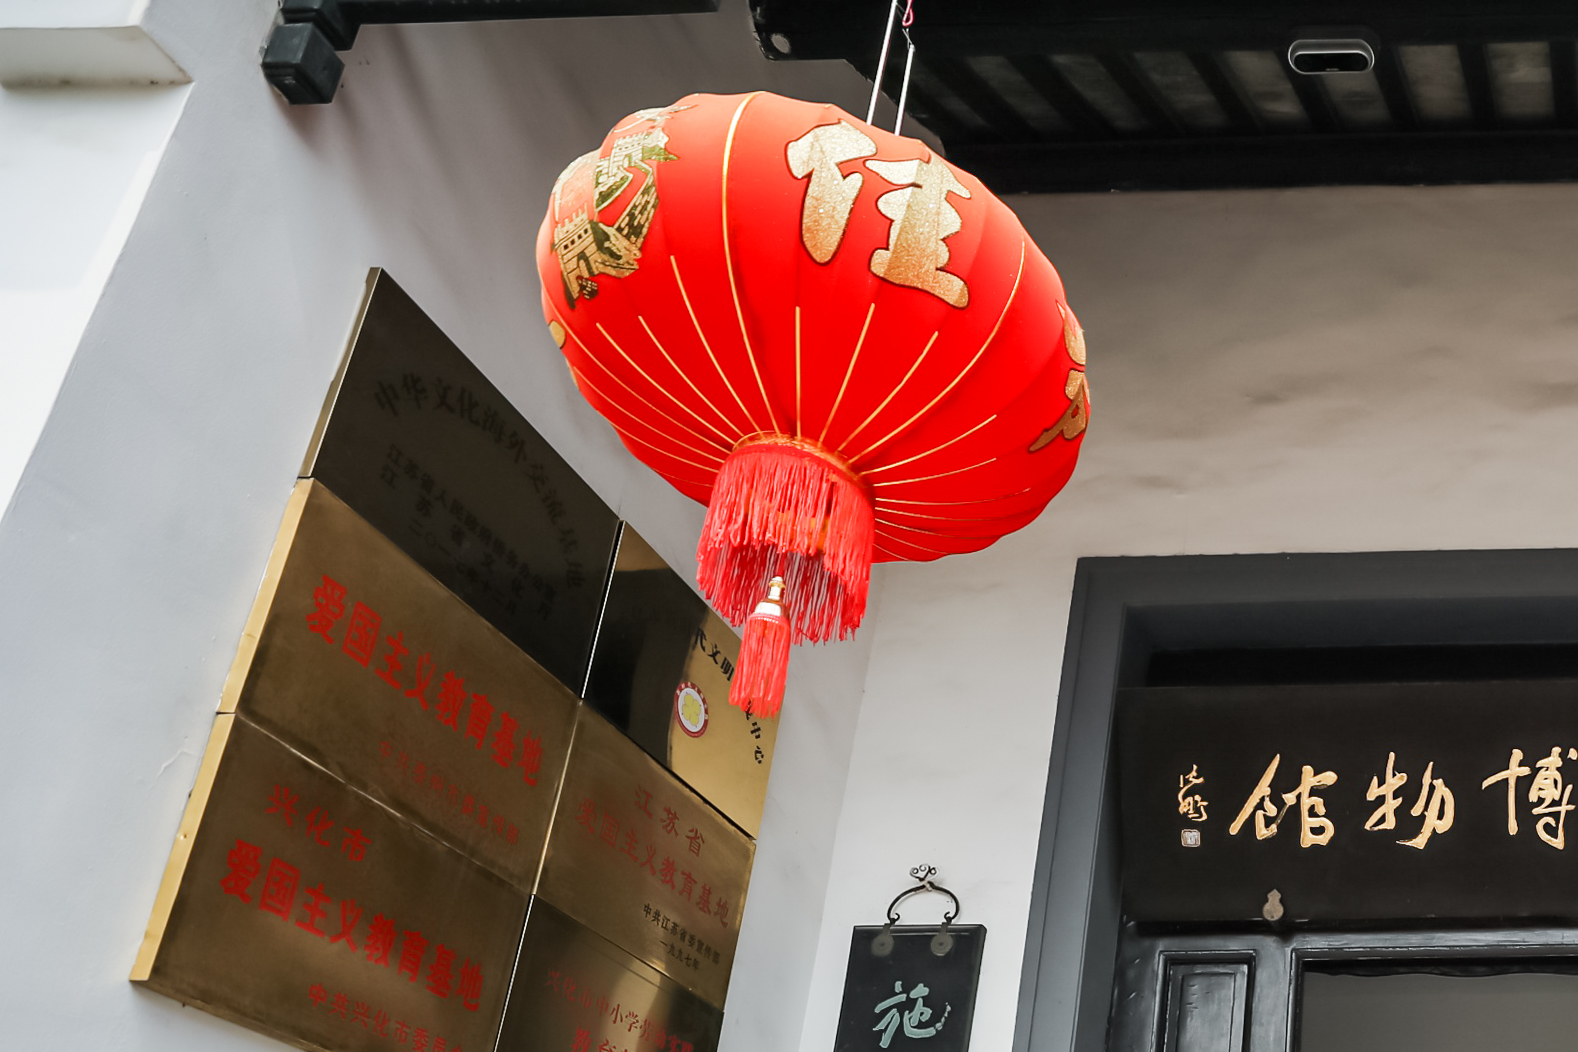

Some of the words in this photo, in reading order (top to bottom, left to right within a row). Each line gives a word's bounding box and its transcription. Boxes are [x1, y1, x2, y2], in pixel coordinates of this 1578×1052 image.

[785, 119, 972, 309] 佳
[306, 575, 542, 785] 爱国主义教育基地
[264, 784, 371, 861] 兴化市
[575, 797, 730, 928] 爱国主义教育基地
[634, 784, 705, 858] 江苏省
[219, 839, 485, 1012] 爱国主义教育基地
